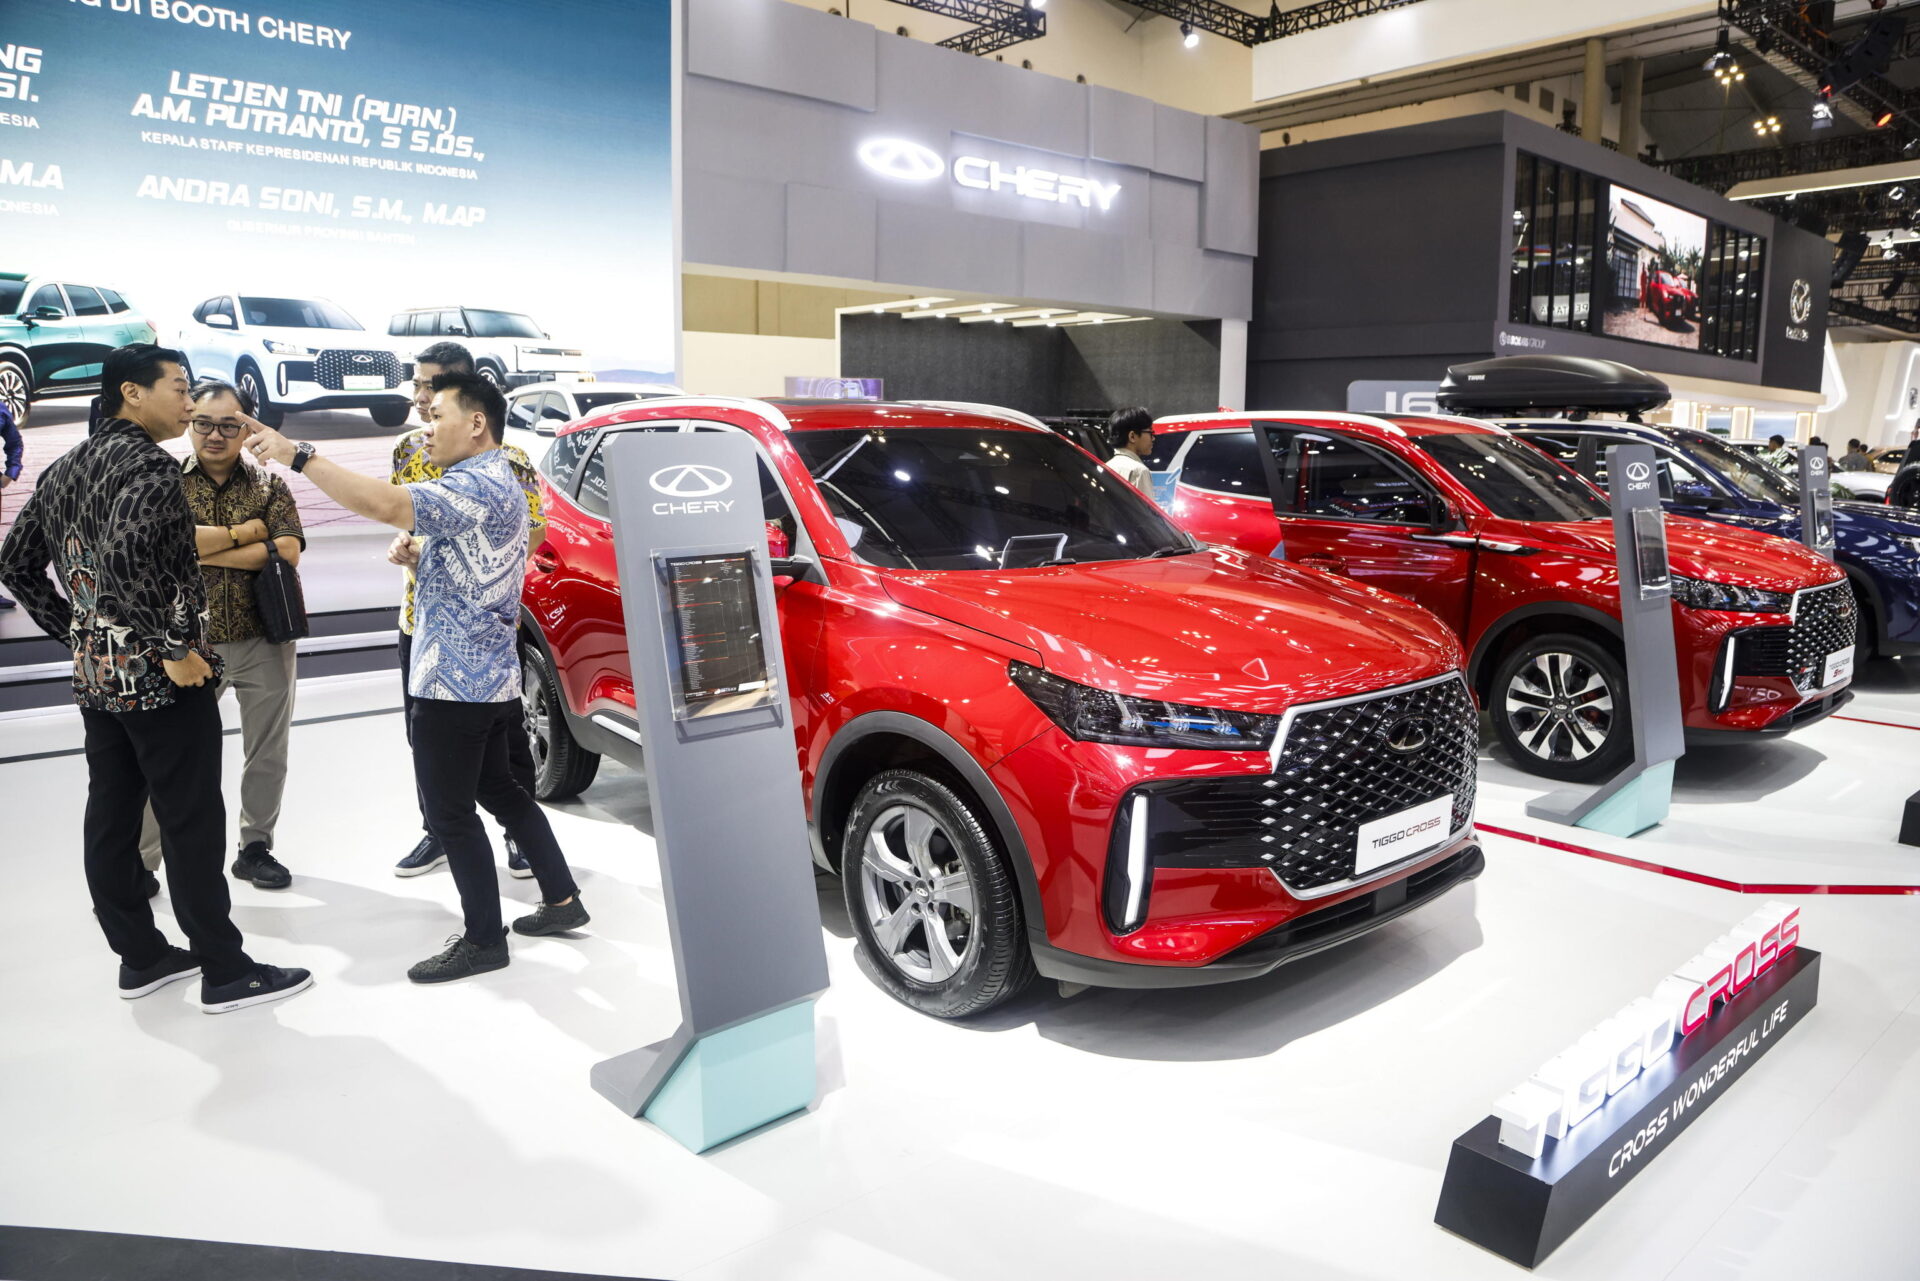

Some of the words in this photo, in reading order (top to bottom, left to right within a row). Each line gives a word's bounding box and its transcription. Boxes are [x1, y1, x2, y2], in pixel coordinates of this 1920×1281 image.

[150, 0, 250, 34] BOOTH
[257, 16, 352, 50] CHERY
[130, 93, 197, 124] A.M.
[205, 102, 371, 149] PUTRANTO,
[380, 126, 402, 149] S
[168, 70, 289, 110] LETJEN
[297, 88, 343, 118] TNI
[352, 94, 457, 136] (PURN.)
[141, 130, 199, 149] KEPALA
[200, 138, 244, 154] STAFF
[246, 143, 350, 166] KEPRESIDENAN
[352, 155, 414, 173] REPUBLIK
[415, 163, 479, 180] INDONESIA
[136, 174, 251, 209] ANDRA
[258, 186, 342, 219] SONI,
[953, 156, 1122, 211] CHERY
[652, 500, 735, 516] CHERY
[1628, 481, 1651, 491] CHERY
[1496, 1000, 1677, 1159] TIGGO
[1680, 906, 1801, 1036] CROSS
[1608, 1108, 1669, 1179] CROSS
[1672, 1028, 1760, 1122] WONDERFUL
[1762, 999, 1790, 1045] LIFE
